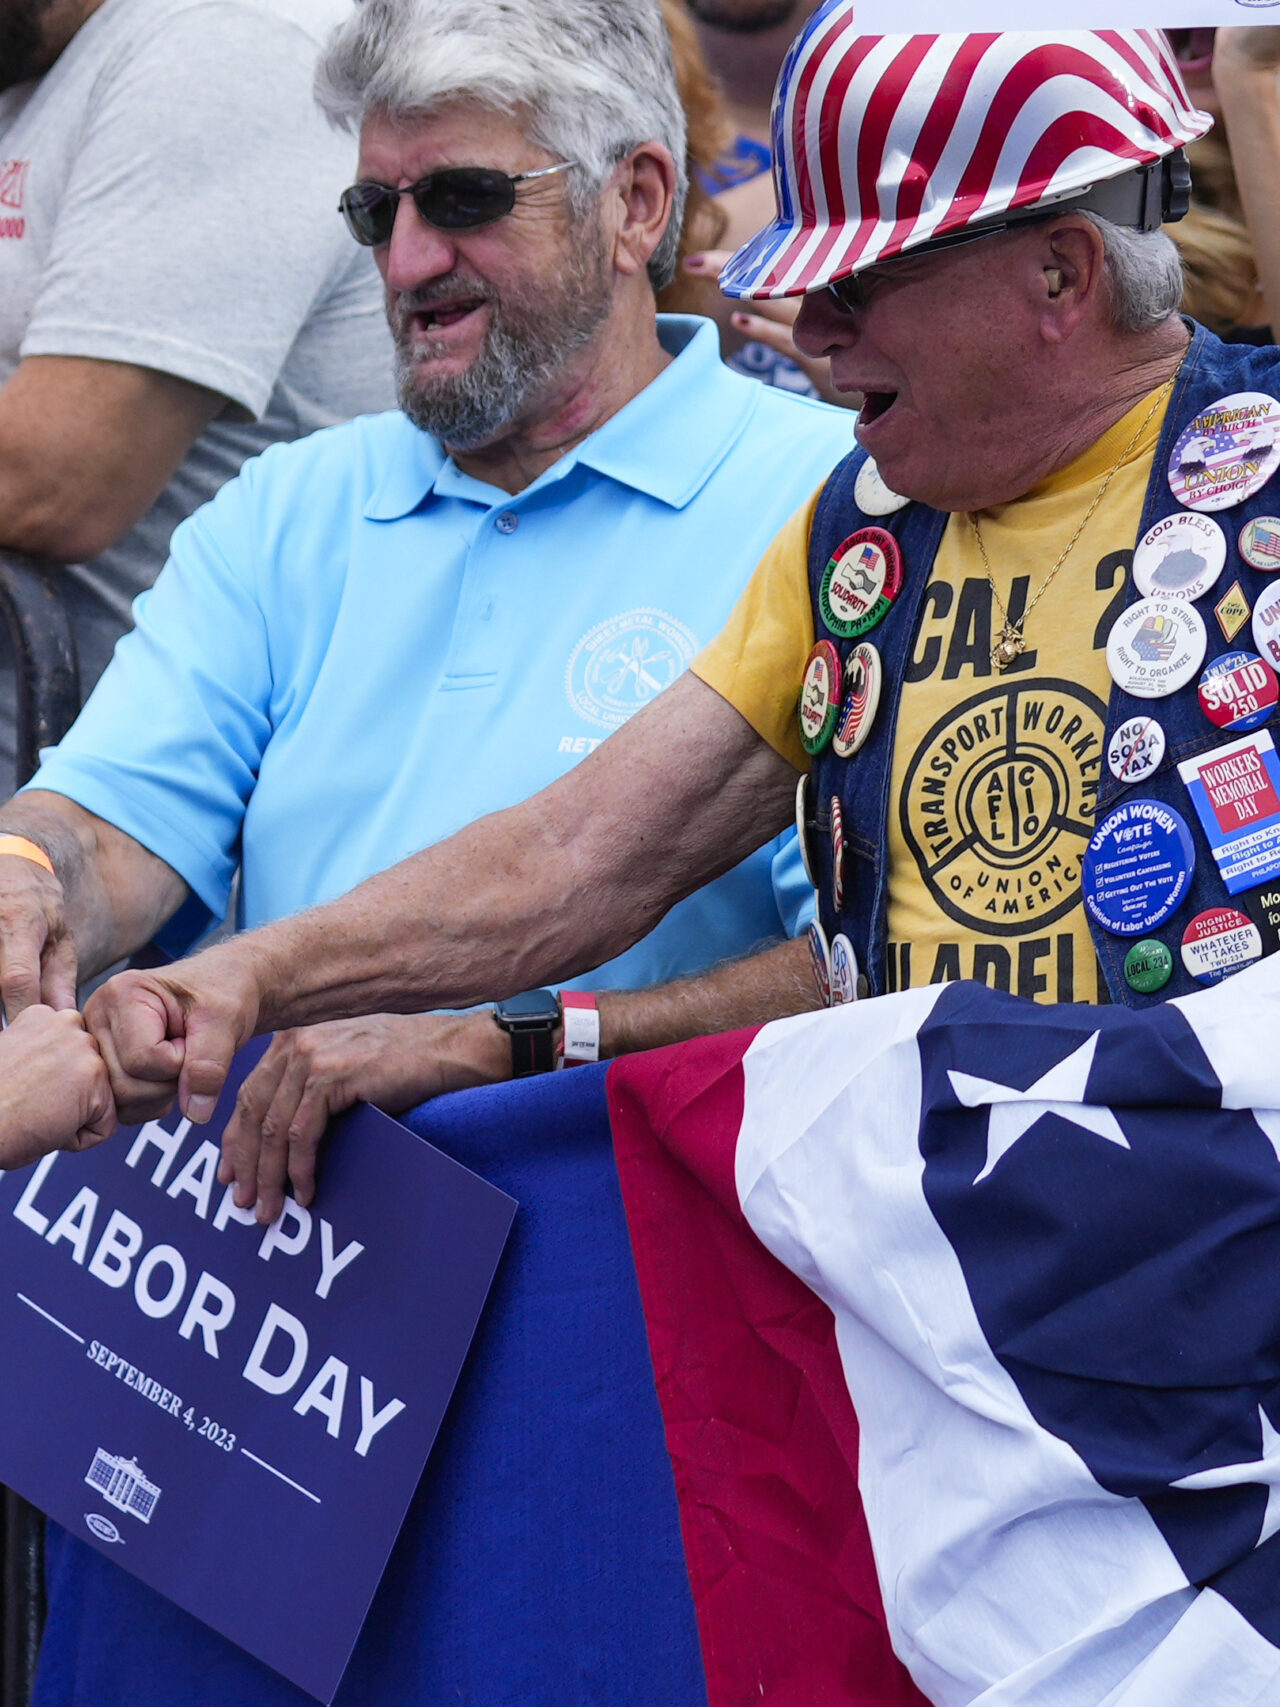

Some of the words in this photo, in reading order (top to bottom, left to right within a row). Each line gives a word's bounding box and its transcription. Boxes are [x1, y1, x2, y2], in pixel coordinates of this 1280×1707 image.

[1190, 403, 1272, 430] AMERICAN
[1202, 427, 1217, 437] BY
[1220, 419, 1256, 433] BIRTH
[1184, 460, 1261, 491] UNION
[1189, 489, 1205, 500] BY
[1206, 479, 1251, 496] CHOICE
[838, 531, 869, 555] LABOR
[1145, 520, 1173, 546] GOD
[1178, 516, 1216, 537] BLESS
[831, 581, 869, 615] SOLIDARITY
[1122, 606, 1150, 627] RIGHT
[1155, 604, 1168, 612] TO
[1171, 607, 1197, 634] STRIKE
[1220, 607, 1246, 617] COPE
[1116, 646, 1134, 668] RIGHT
[1135, 666, 1146, 676] TO
[1149, 653, 1191, 677] ORGANIZE
[1201, 663, 1269, 710] SOLID
[1229, 694, 1259, 720] 250
[1120, 723, 1143, 742] NO
[1110, 733, 1160, 764] SODA
[1120, 753, 1153, 776] TAX
[1200, 750, 1261, 788] WORKERS
[921, 706, 1004, 858] TRANSPORT
[1023, 701, 1102, 819] WORKERS
[1210, 771, 1268, 808] MEMORIAL
[986, 772, 1006, 841] AFL
[1018, 766, 1040, 836] CIO
[1233, 796, 1260, 821] DAY
[1090, 809, 1128, 851] UNION
[1129, 805, 1177, 834] WOMEN
[1113, 822, 1152, 843] VOTE
[1221, 838, 1251, 855] Right
[1252, 833, 1263, 842] to
[1265, 824, 1280, 837] Kn
[1117, 840, 1153, 854] Campaign
[1232, 844, 1262, 861] Right
[1262, 841, 1273, 850] to
[977, 855, 1062, 893] UNION
[1225, 859, 1255, 876] Right
[1255, 854, 1267, 862] to
[950, 875, 974, 900] OF
[1260, 892, 1280, 909] Mo
[1087, 895, 1111, 927] Coalition
[1111, 921, 1121, 930] of
[1121, 921, 1144, 931] Labor
[1144, 905, 1168, 926] Union
[1165, 871, 1186, 906] Women
[1195, 910, 1239, 930] DIGNITY
[1198, 917, 1243, 938] JUSTICE
[1268, 911, 1280, 925] fo
[1190, 929, 1253, 955] WHATEVER
[1199, 952, 1209, 963] IT
[1213, 941, 1250, 959] TAKES
[1126, 960, 1151, 977] LOCAL
[1153, 955, 1169, 969] 234
[1210, 953, 1244, 968] TWU-234
[1209, 970, 1222, 978] The
[125, 1116, 365, 1300] HAPPY
[13, 1150, 236, 1359] LABOR
[242, 1303, 407, 1457] DAY
[86, 1340, 183, 1418] SEPTEMBER
[183, 1407, 196, 1431] 4,
[197, 1416, 237, 1452] 2023
